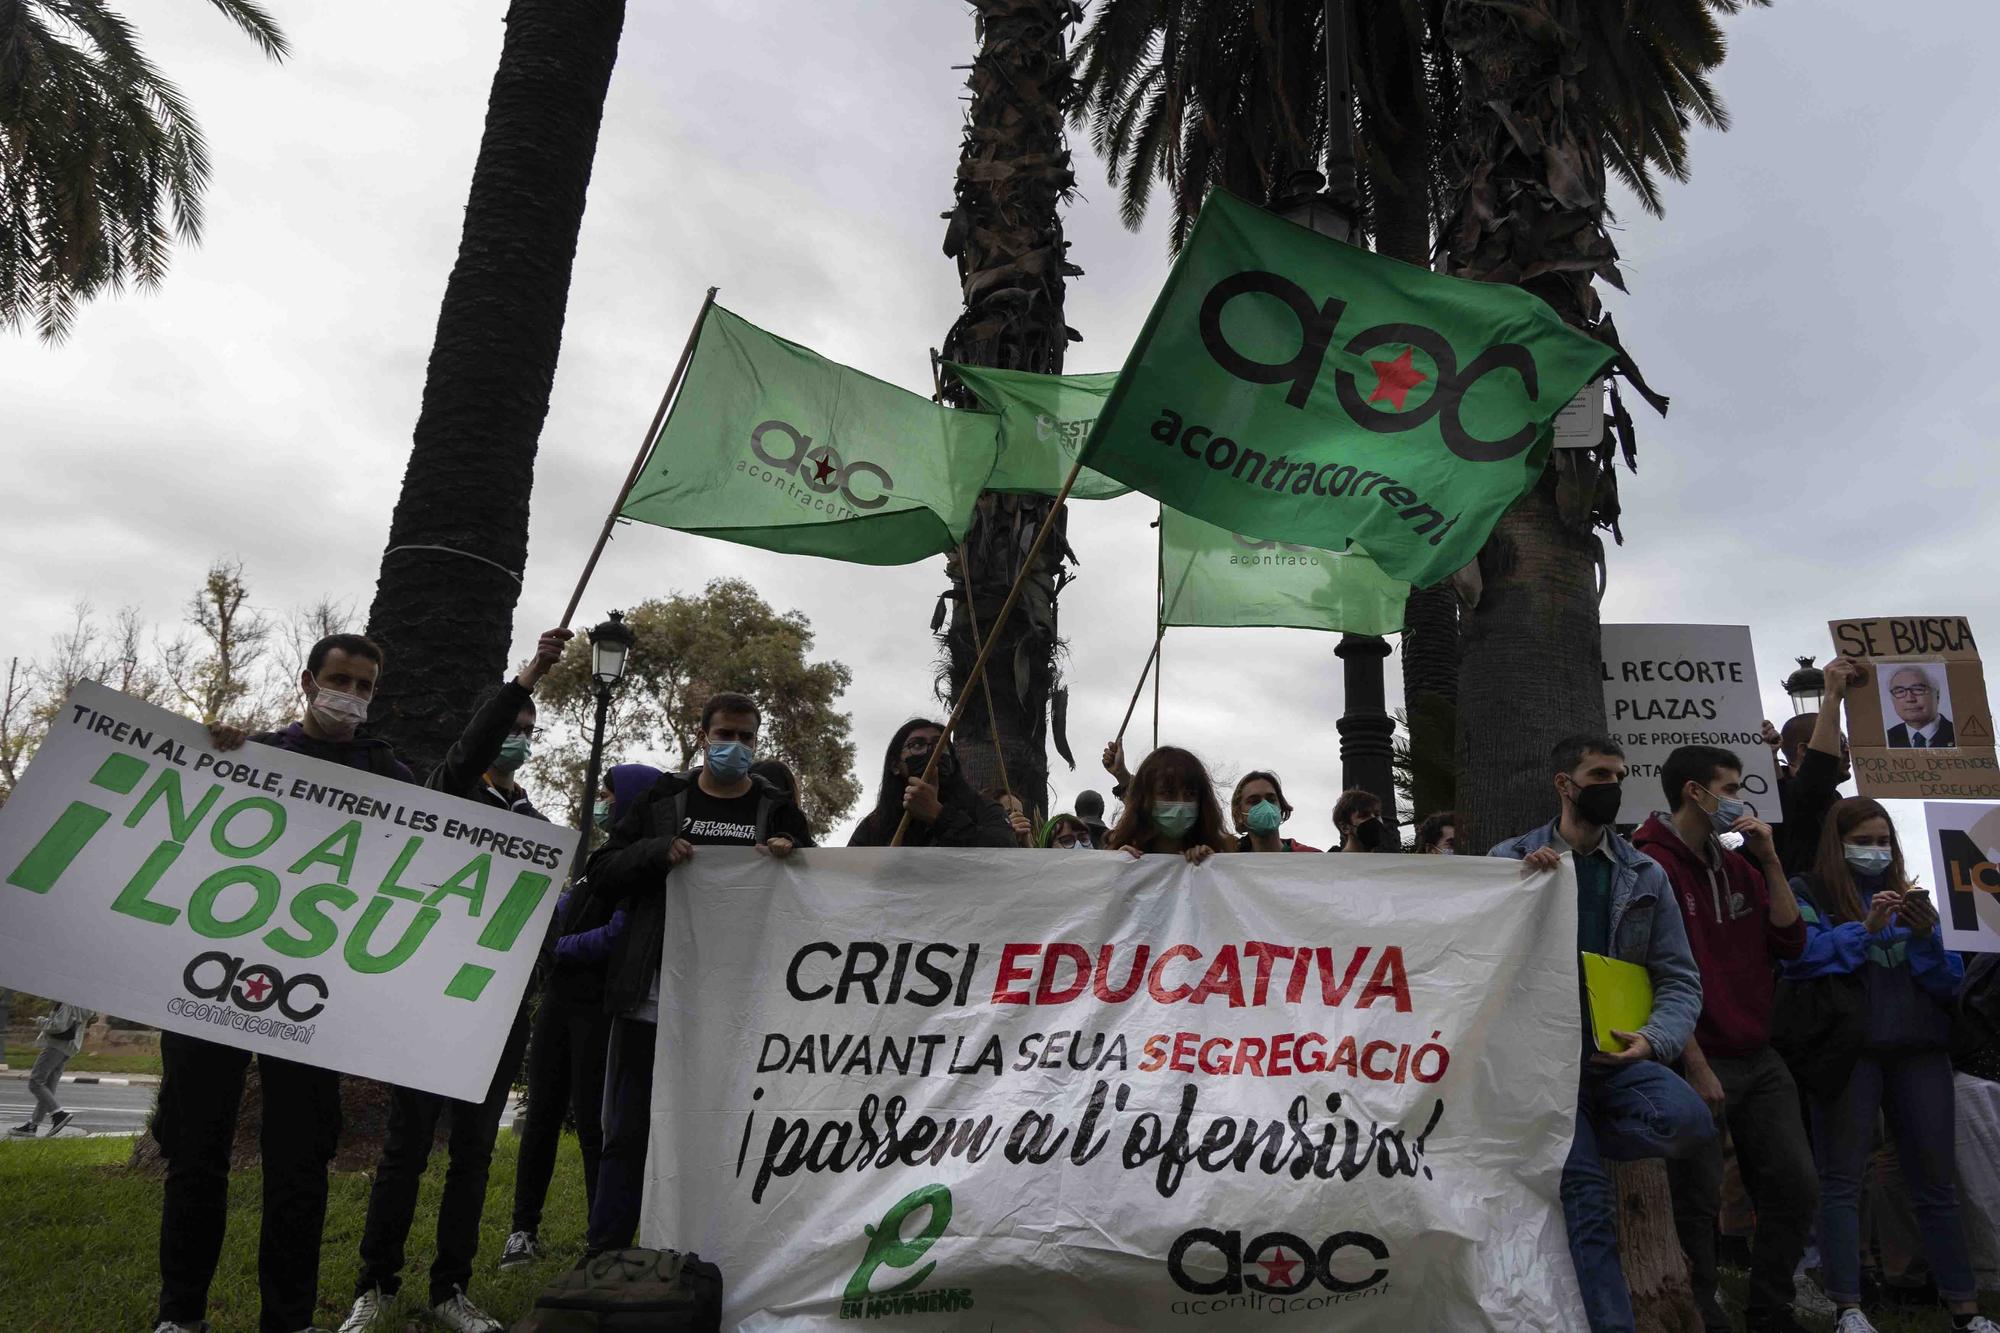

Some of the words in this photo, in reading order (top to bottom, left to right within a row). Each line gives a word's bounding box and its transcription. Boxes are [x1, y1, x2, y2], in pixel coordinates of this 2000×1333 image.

[1150, 408, 1463, 546] acontracorrent
[1836, 621, 1885, 658] SE
[1889, 618, 1978, 656] BUSCA
[1622, 659, 1743, 684] RECORTE
[1615, 698, 1717, 721] PLAZAS
[1628, 732, 1648, 746] DE
[1652, 731, 1763, 746] PROFESORADO
[1855, 757, 1888, 772] POR
[1892, 757, 1916, 771] NO
[1866, 770, 1942, 784] NUESTROS
[73, 704, 154, 750] TIREN
[152, 737, 188, 767] AL
[193, 752, 284, 798] POBLE,
[289, 778, 392, 820] ENTREN
[393, 805, 438, 833] LES
[442, 818, 564, 870] EMPRESES
[1919, 783, 2000, 797] DERECHOS
[690, 827, 704, 835] EN
[287, 819, 362, 885] A
[376, 835, 492, 917] LA
[786, 941, 980, 1007] CRISI
[990, 941, 1413, 1013] EDUCATIVA
[167, 996, 316, 1045] acontracorrent
[757, 1033, 946, 1077] DAVANT
[947, 1034, 1003, 1076] LA
[1012, 1030, 1128, 1072] SEUA
[1137, 1030, 1450, 1084] SEGREGACIÓ
[1003, 1109, 1069, 1165] a
[840, 1300, 864, 1320] EN
[865, 1291, 975, 1320] MOVIMIENTO
[1171, 1281, 1393, 1315] acontracorrent
